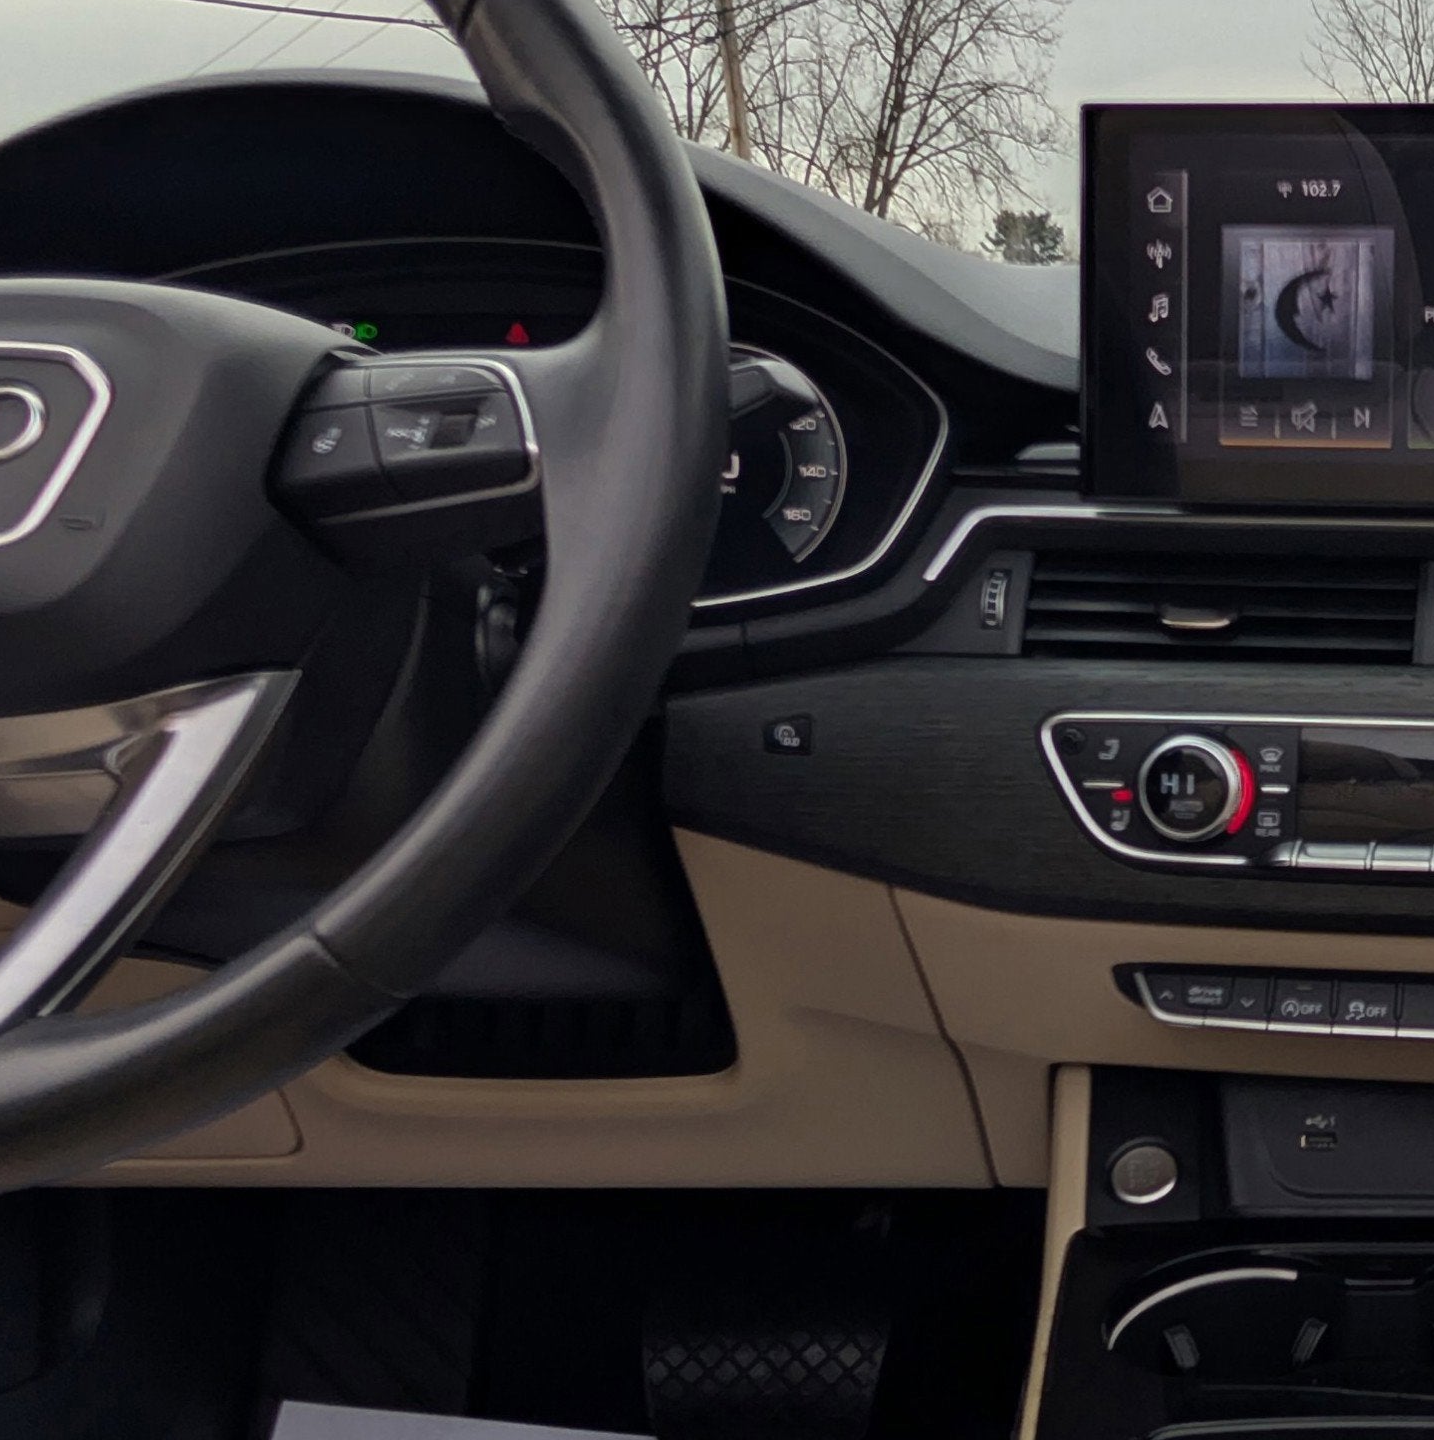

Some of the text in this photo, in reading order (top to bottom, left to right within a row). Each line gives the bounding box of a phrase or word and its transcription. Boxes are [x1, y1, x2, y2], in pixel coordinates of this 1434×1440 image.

[1301, 180, 1341, 198] 102.7
[798, 464, 827, 478] 140
[783, 507, 812, 522] 160
[1160, 772, 1195, 795] HI
[1301, 1003, 1322, 1016] OFF
[1366, 1005, 1388, 1018] OFF
